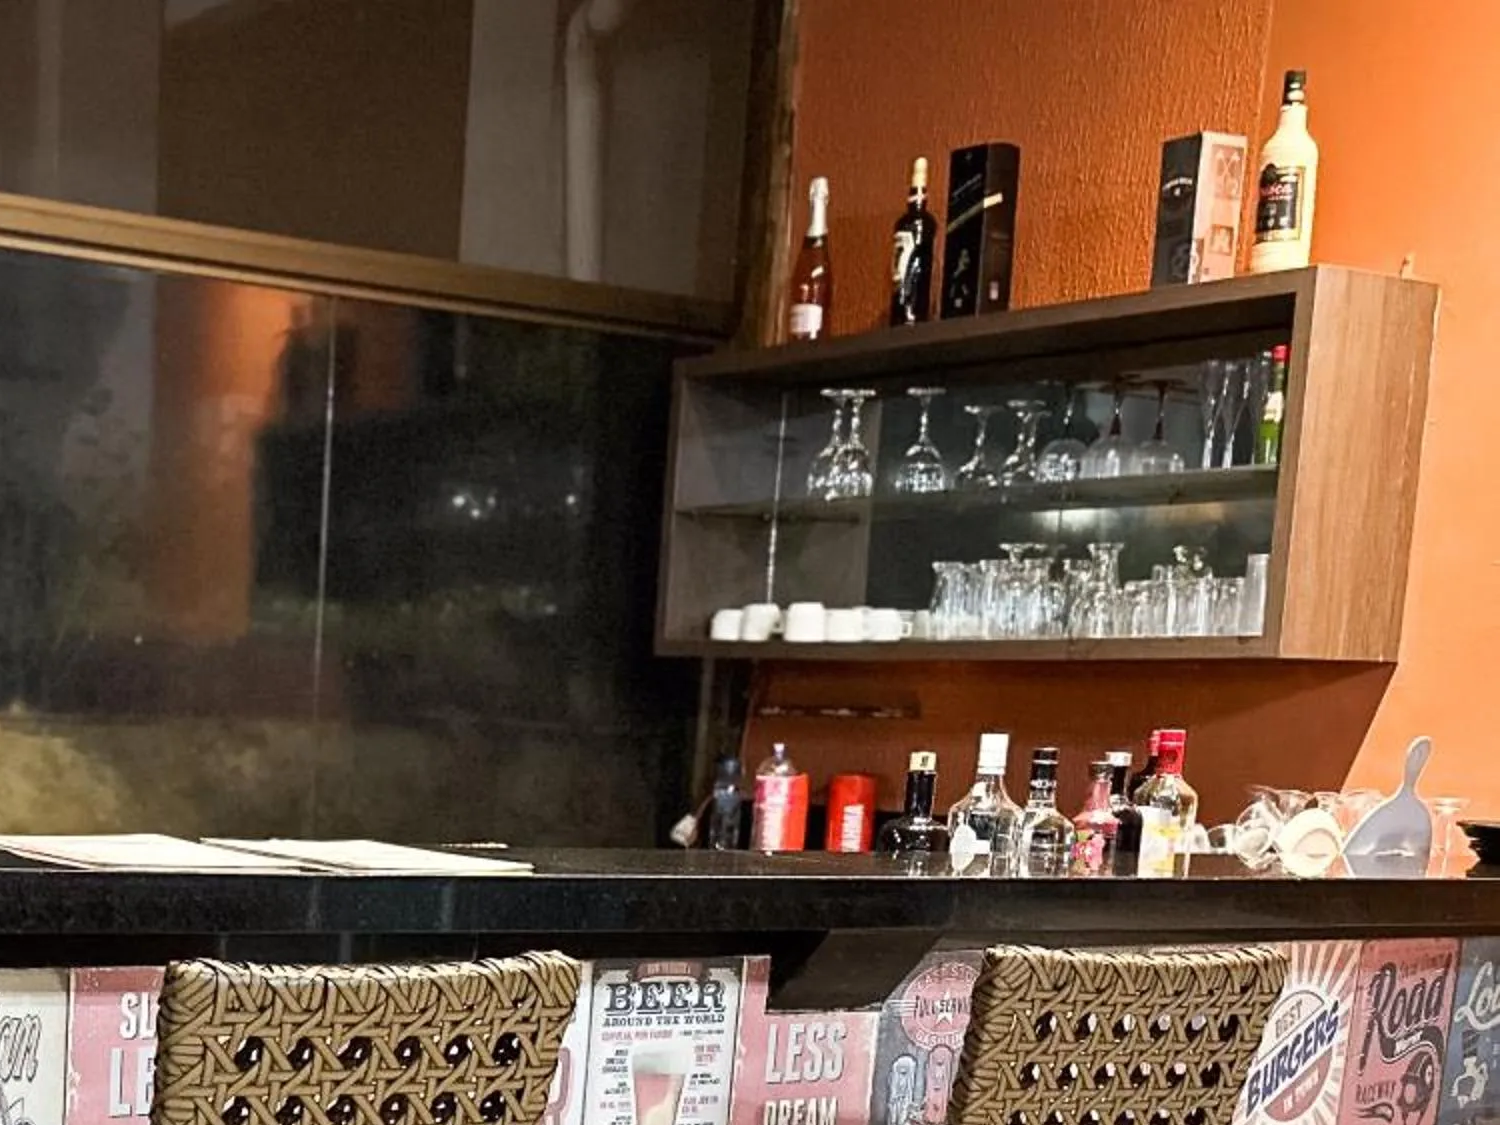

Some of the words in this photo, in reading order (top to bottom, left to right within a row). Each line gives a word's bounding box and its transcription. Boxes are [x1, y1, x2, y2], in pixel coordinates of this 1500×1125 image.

[602, 1015, 653, 1027] AROUND
[656, 1015, 680, 1025] THE
[684, 1014, 725, 1025] WORLD
[604, 981, 726, 1016] BEER
[766, 1022, 847, 1083] LESS
[1246, 1000, 1338, 1119] BURGERS
